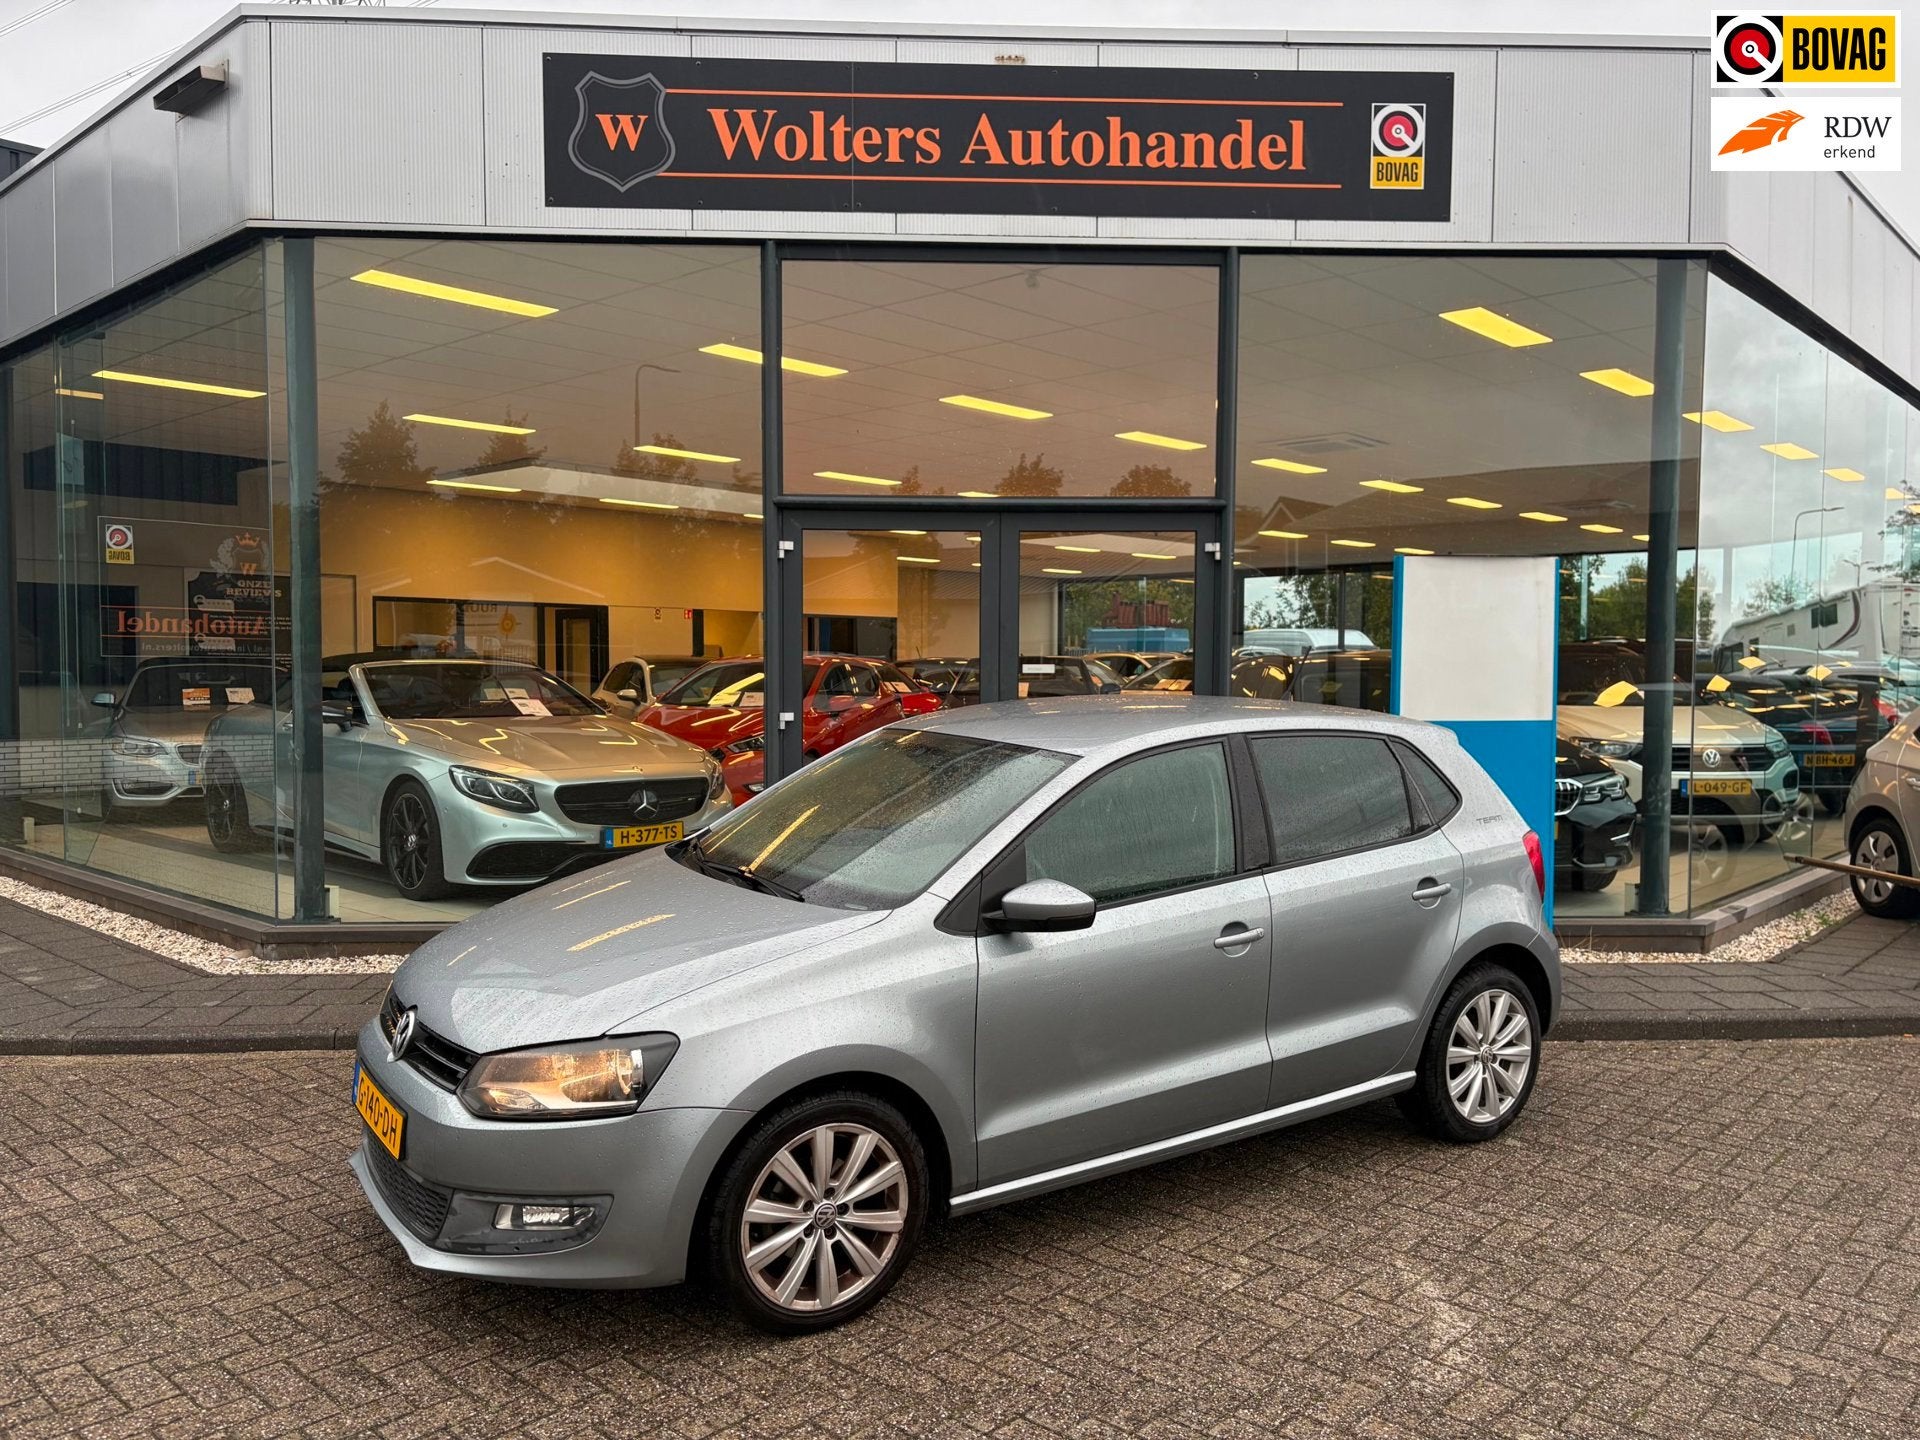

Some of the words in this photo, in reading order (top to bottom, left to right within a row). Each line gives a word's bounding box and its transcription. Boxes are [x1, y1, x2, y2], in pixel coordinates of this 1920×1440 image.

[595, 114, 649, 151] W
[706, 108, 942, 164] Wolters
[959, 113, 1307, 171] Autohandel
[1376, 161, 1419, 183] BOVAG
[620, 825, 677, 844] H-377-TS
[359, 1076, 398, 1149] G-140-DH
